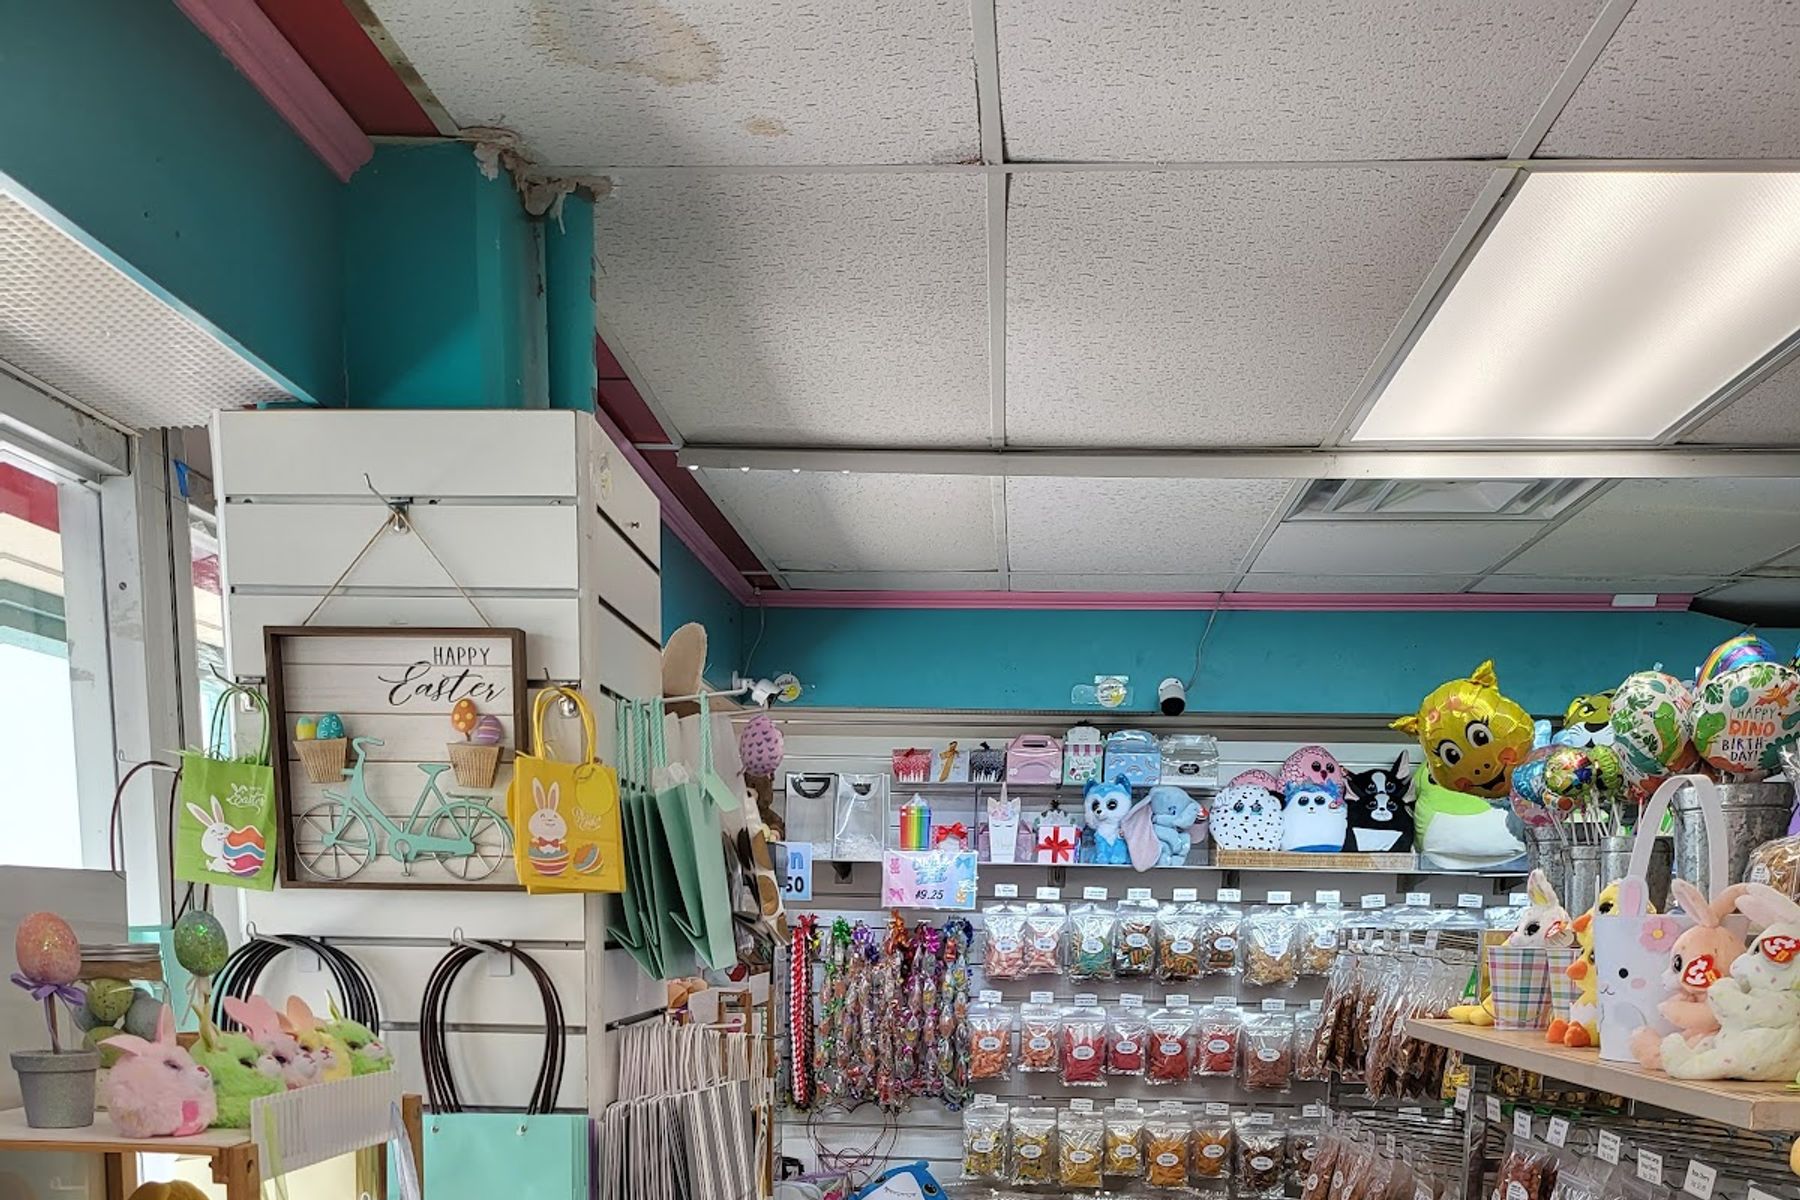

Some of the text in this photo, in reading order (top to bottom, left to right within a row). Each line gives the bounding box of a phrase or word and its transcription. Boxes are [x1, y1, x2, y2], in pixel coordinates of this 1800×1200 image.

[433, 646, 490, 665] HAPPY
[378, 660, 506, 706] Easter
[1737, 707, 1776, 720] HAPPY
[1728, 719, 1776, 737] DINO
[1731, 751, 1758, 762] DAY!
